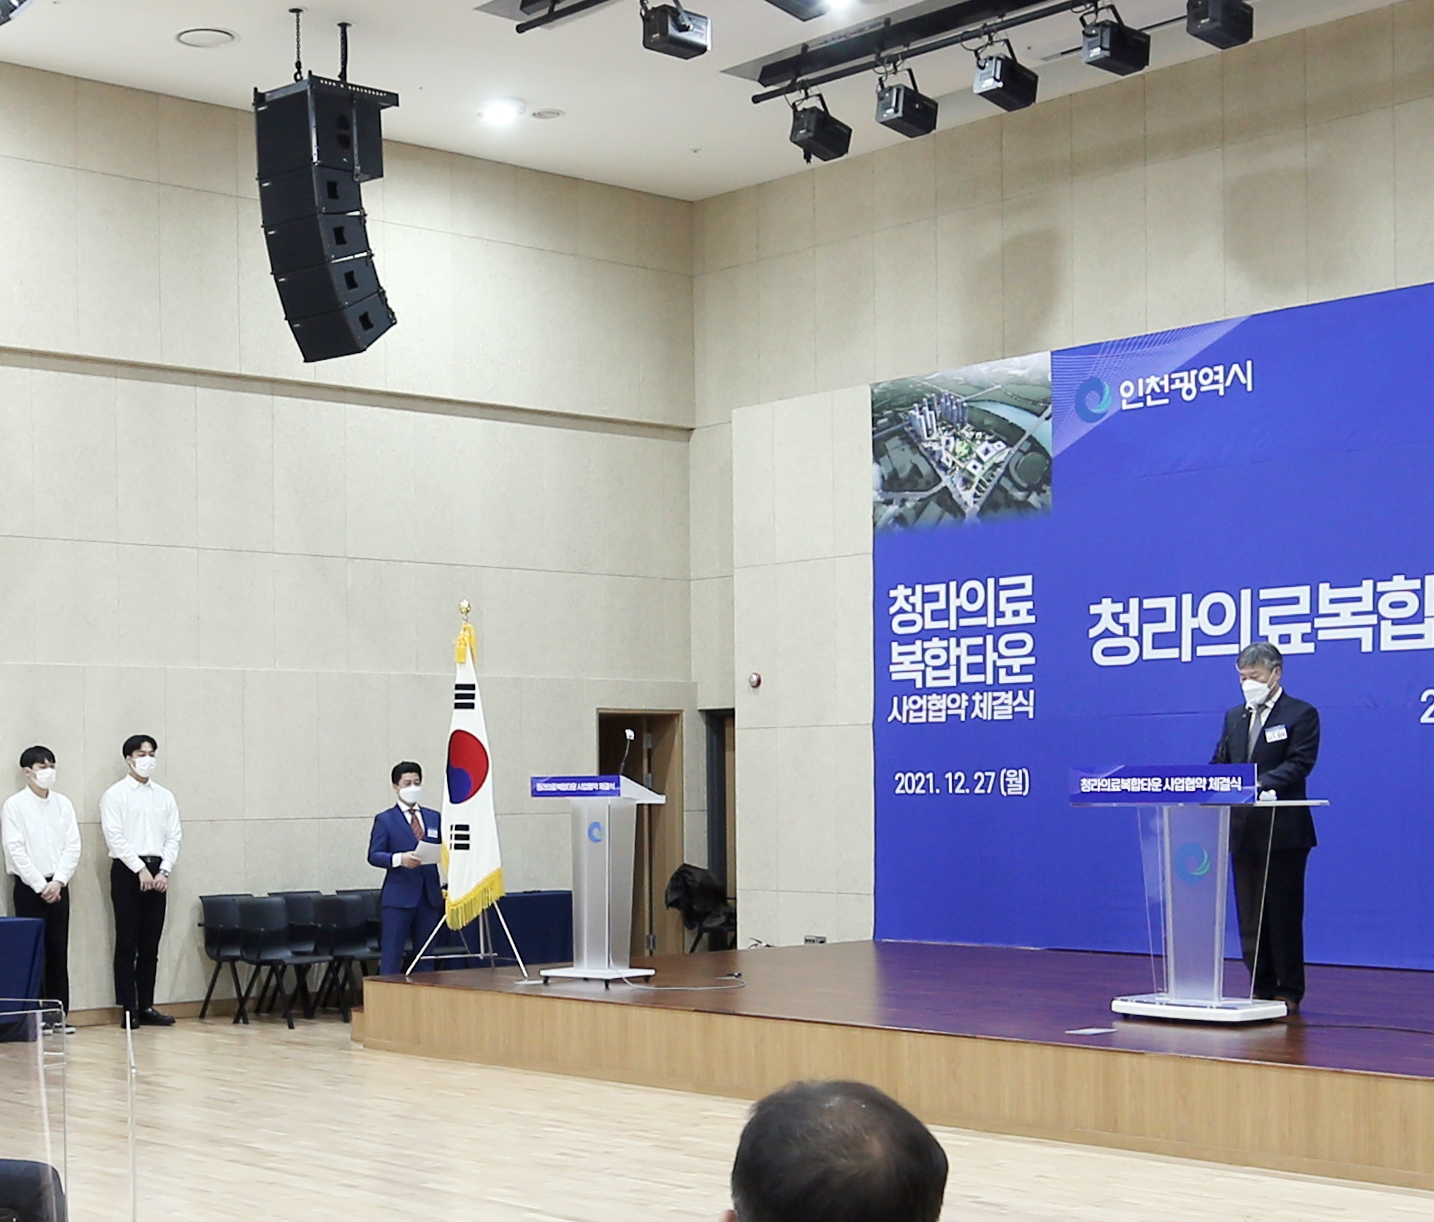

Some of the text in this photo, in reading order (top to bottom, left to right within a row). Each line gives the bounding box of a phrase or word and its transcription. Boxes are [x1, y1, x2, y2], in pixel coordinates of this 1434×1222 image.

[1120, 361, 1251, 409] 인천광역시
[890, 575, 1035, 634] 청라의료
[890, 632, 1035, 688] 복합타운
[888, 690, 1034, 723] 사업협약 체결식
[895, 769, 1029, 796] 2021. 12. 27 (월)
[1081, 777, 1241, 792] 청라의료복합타운 사업협약 체결식
